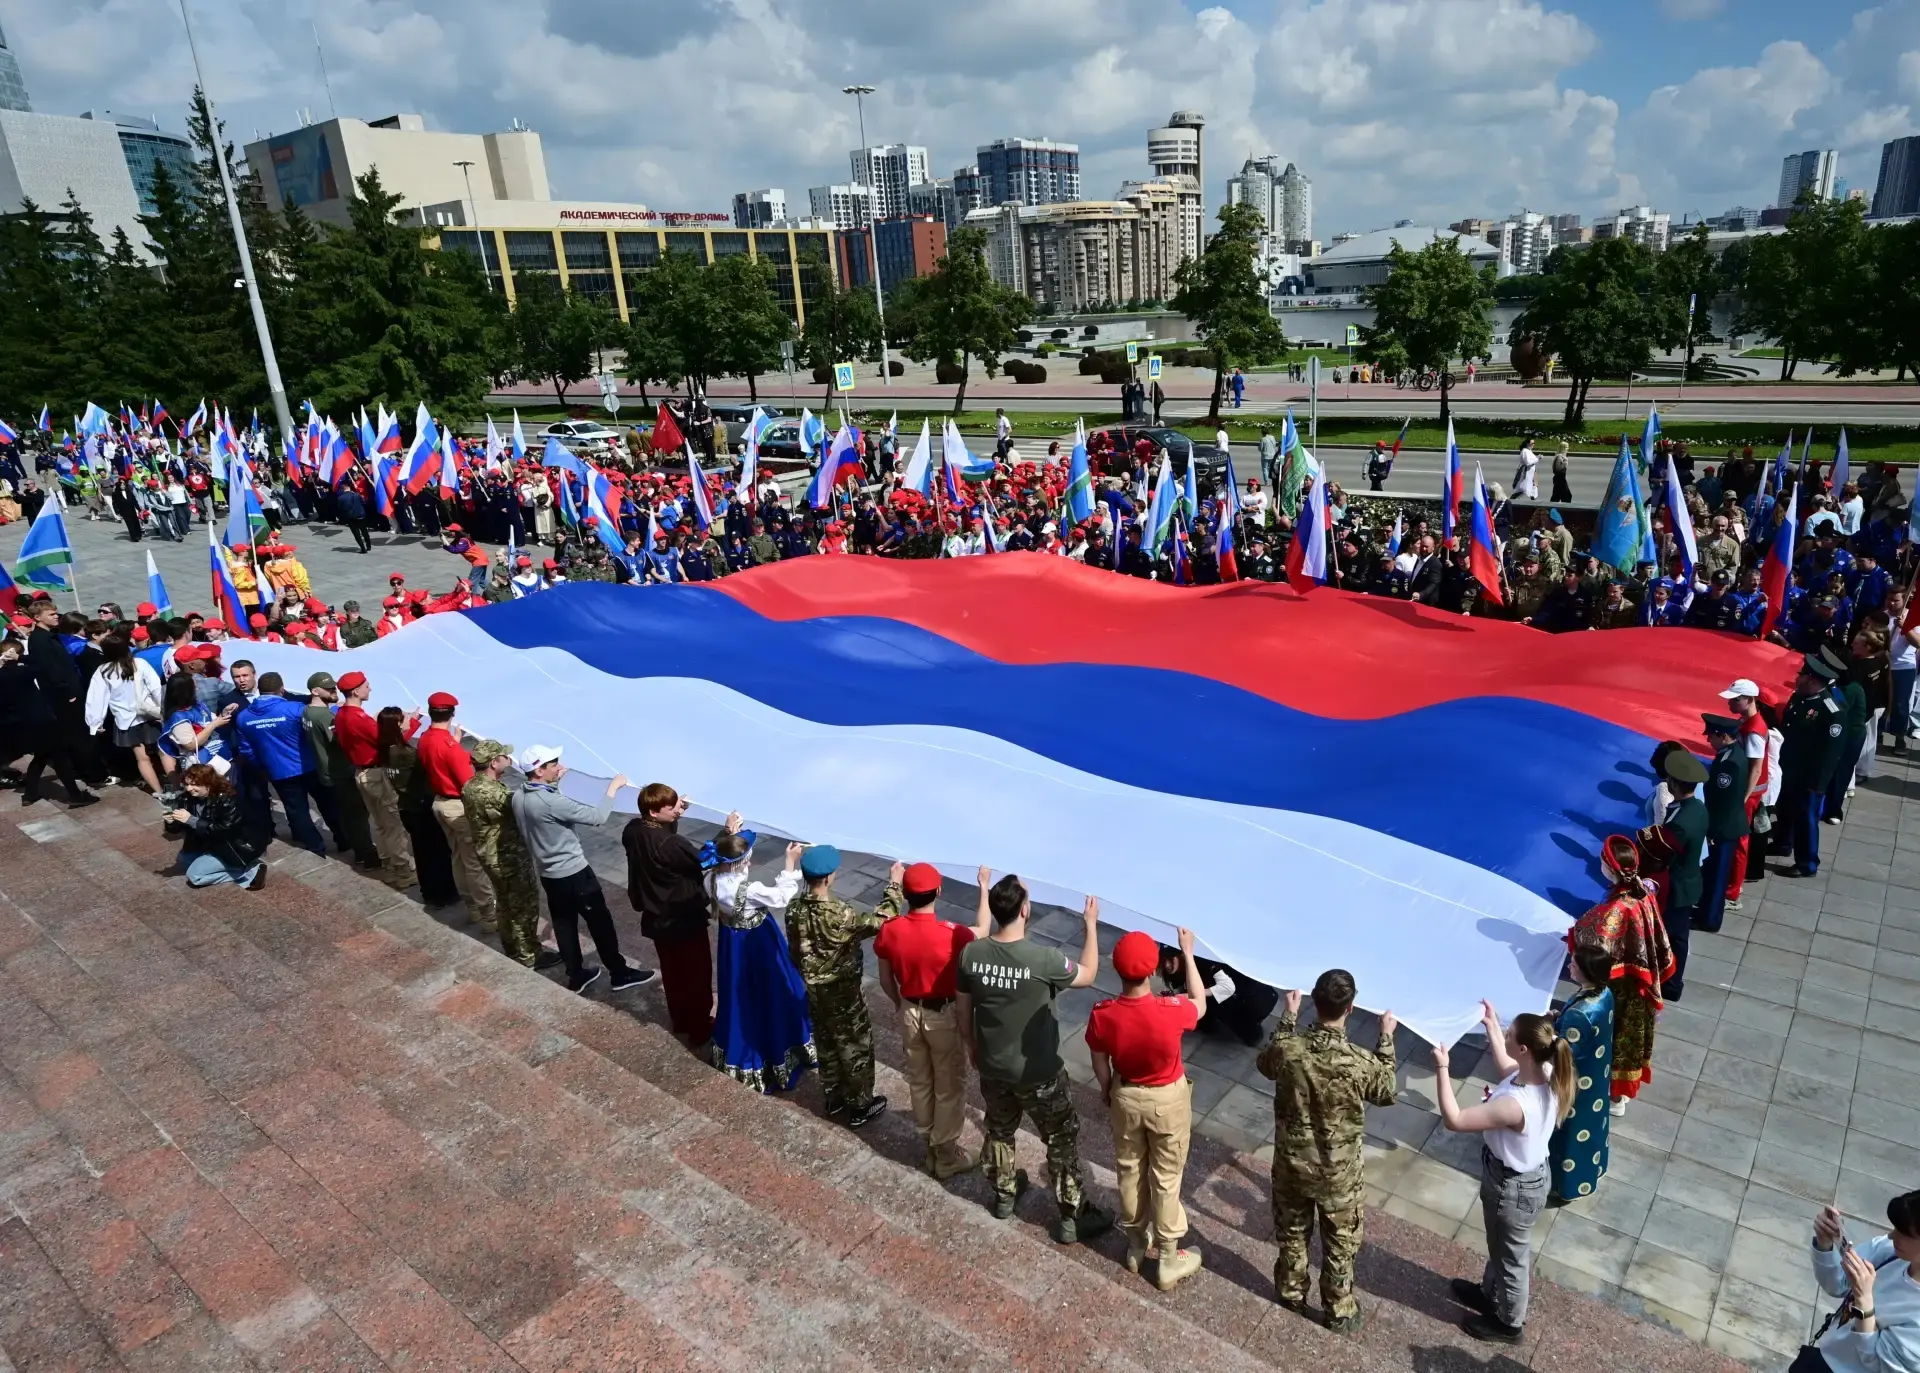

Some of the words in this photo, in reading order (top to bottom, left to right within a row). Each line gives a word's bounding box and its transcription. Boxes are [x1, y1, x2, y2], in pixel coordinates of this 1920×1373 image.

[560, 210, 657, 220] АКАДЕМИЧЕСКИЙ
[659, 212, 691, 221] ТЕАТР
[694, 213, 730, 222] ДРАМЫ
[972, 962, 1031, 980] НАРОДНЫЙ
[982, 975, 1019, 990] ФРОНТ
